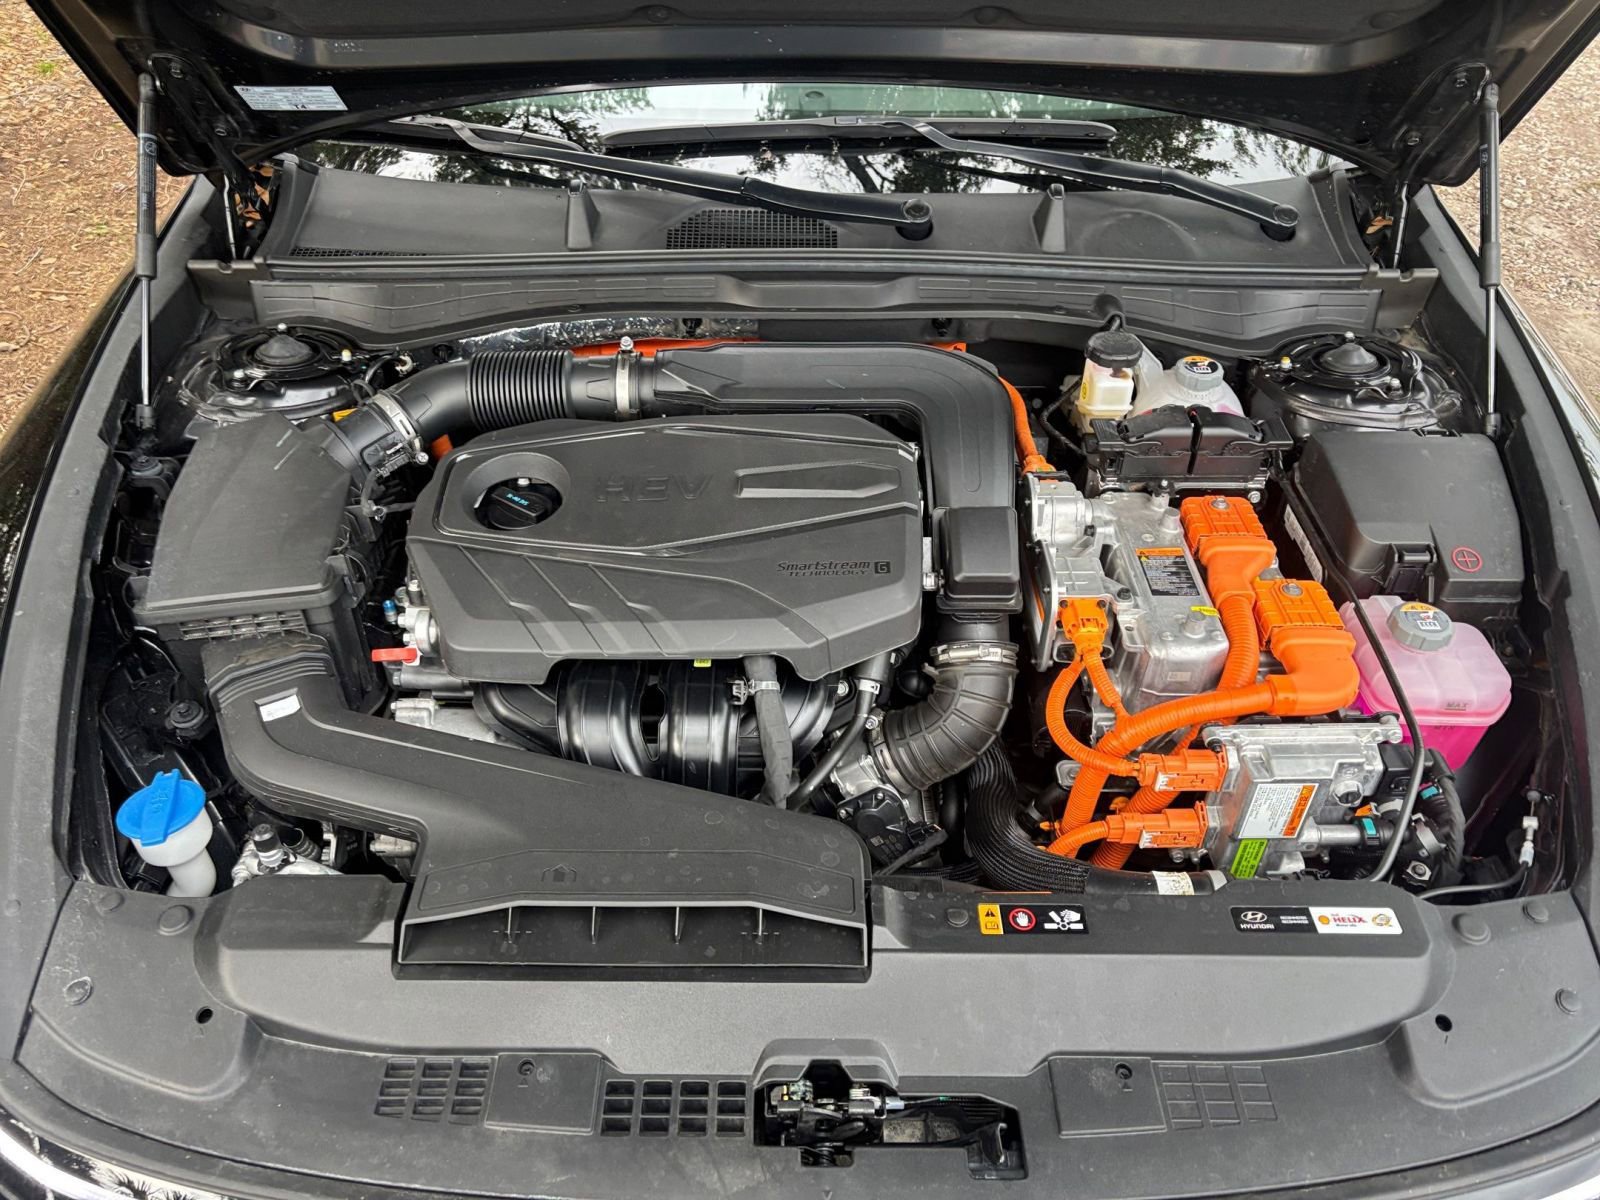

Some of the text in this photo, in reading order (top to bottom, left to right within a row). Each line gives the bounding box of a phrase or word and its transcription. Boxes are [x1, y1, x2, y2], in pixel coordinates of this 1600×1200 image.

[596, 474, 713, 502] HEV
[777, 560, 889, 574] Smartstream G
[1333, 915, 1367, 923] HELIX
